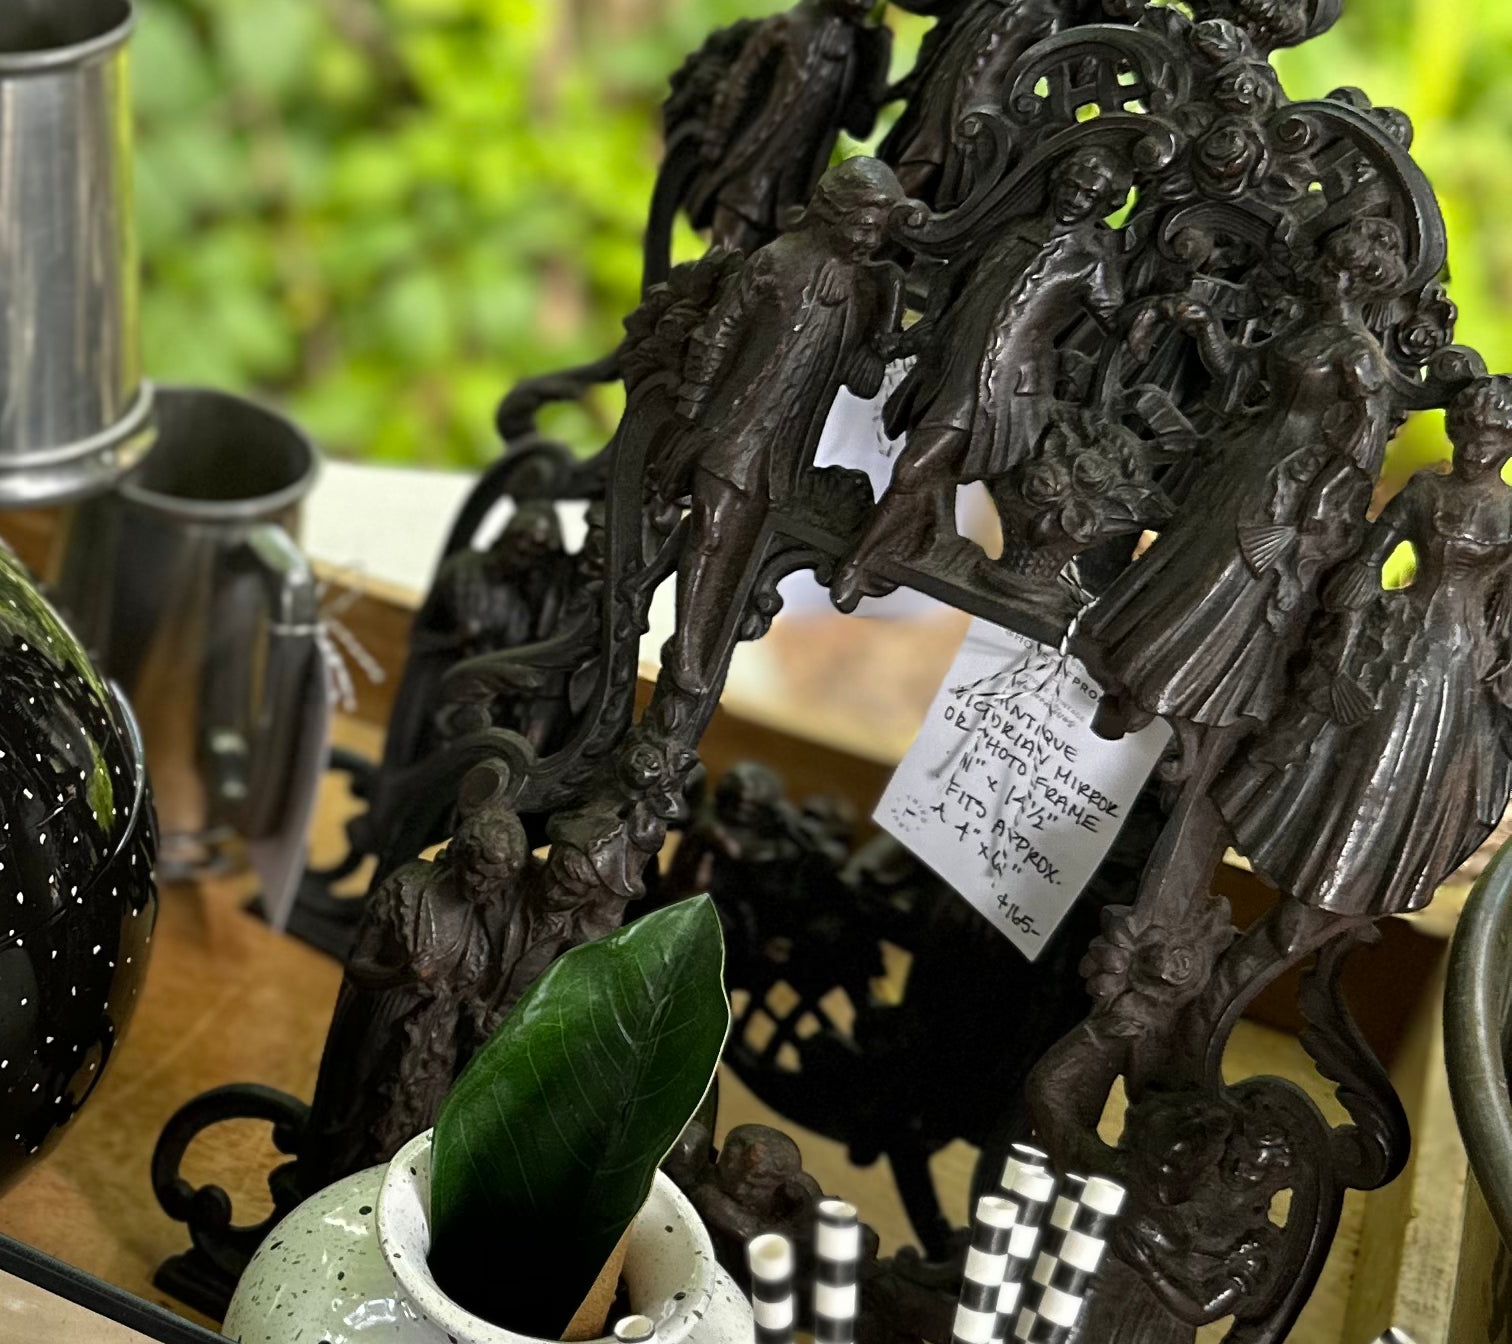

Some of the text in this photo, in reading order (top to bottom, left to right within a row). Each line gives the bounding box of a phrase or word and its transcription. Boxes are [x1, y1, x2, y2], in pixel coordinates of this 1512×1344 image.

[944, 706, 971, 732] OR
[1036, 776, 1100, 833] FRAME
[1054, 766, 1119, 818] MIRROR
[946, 782, 987, 818] FITS
